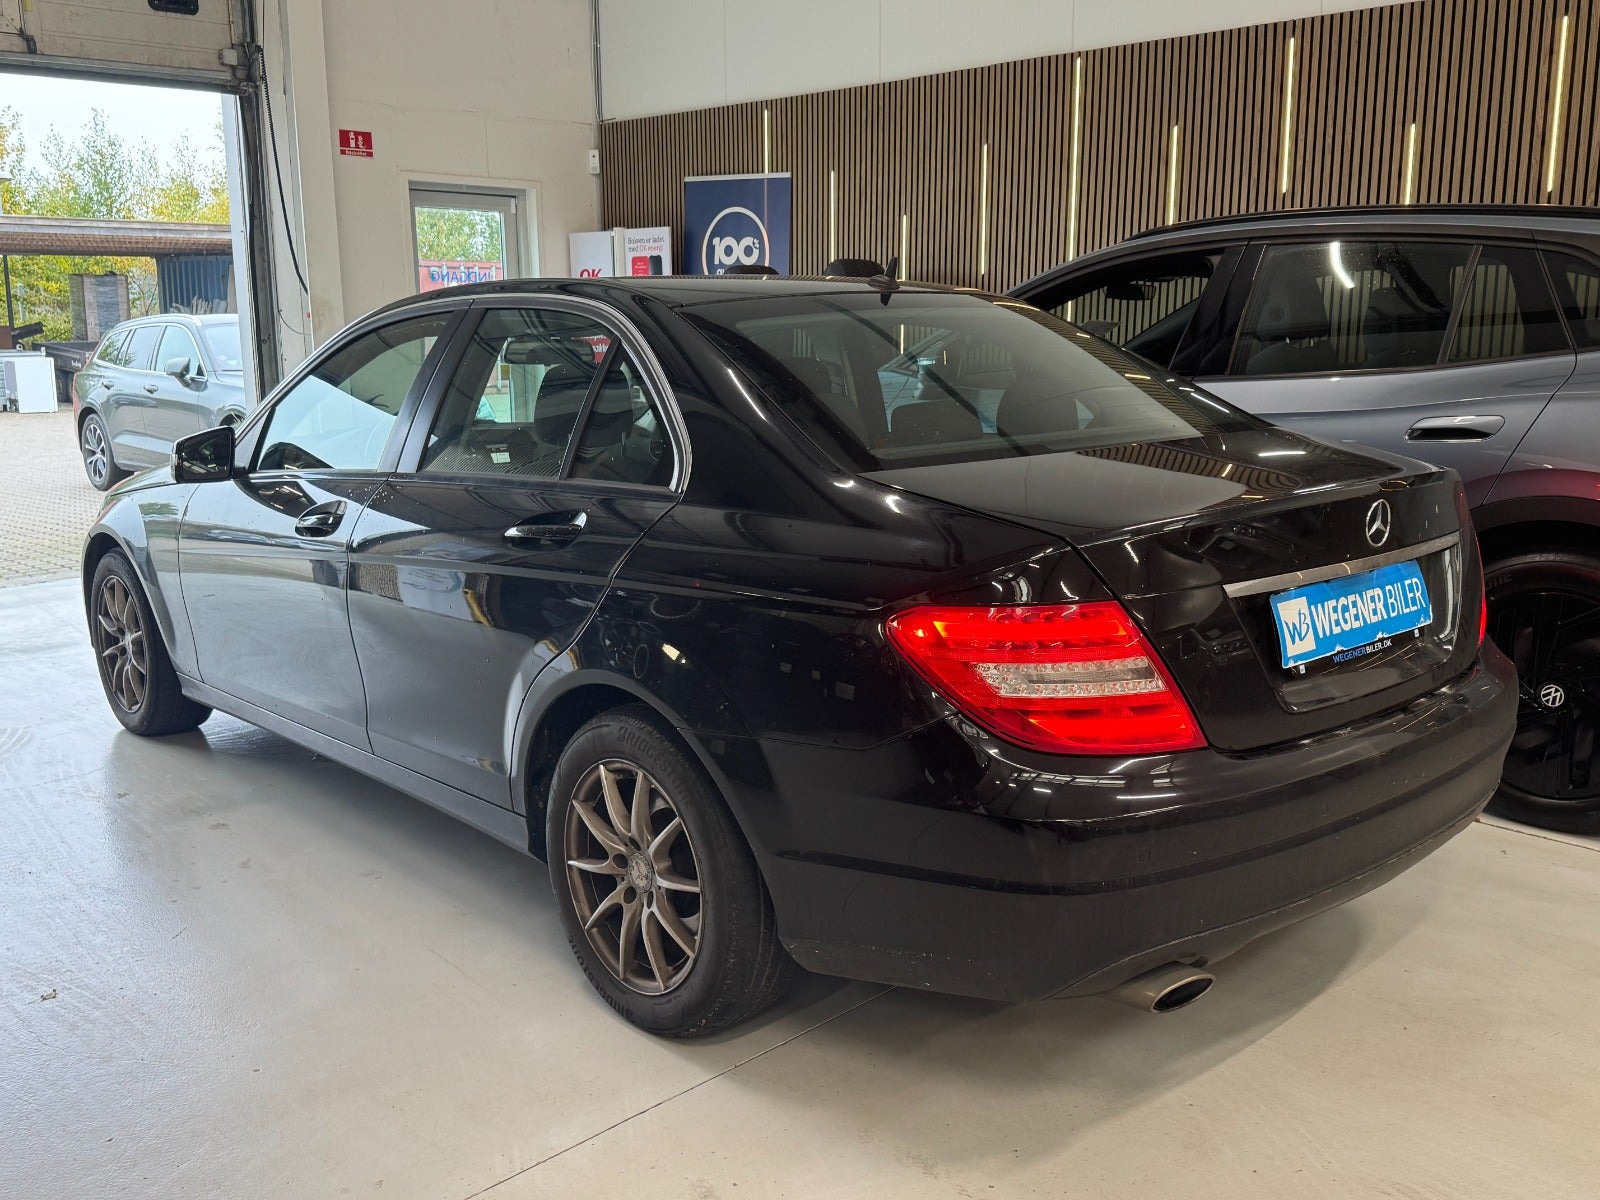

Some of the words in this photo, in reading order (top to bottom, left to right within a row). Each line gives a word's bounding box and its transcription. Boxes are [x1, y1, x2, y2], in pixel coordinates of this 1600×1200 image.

[1311, 587, 1388, 639] WEGENER
[1386, 578, 1426, 618] BILER
[1332, 639, 1392, 664] WEGENERBILER.DK
